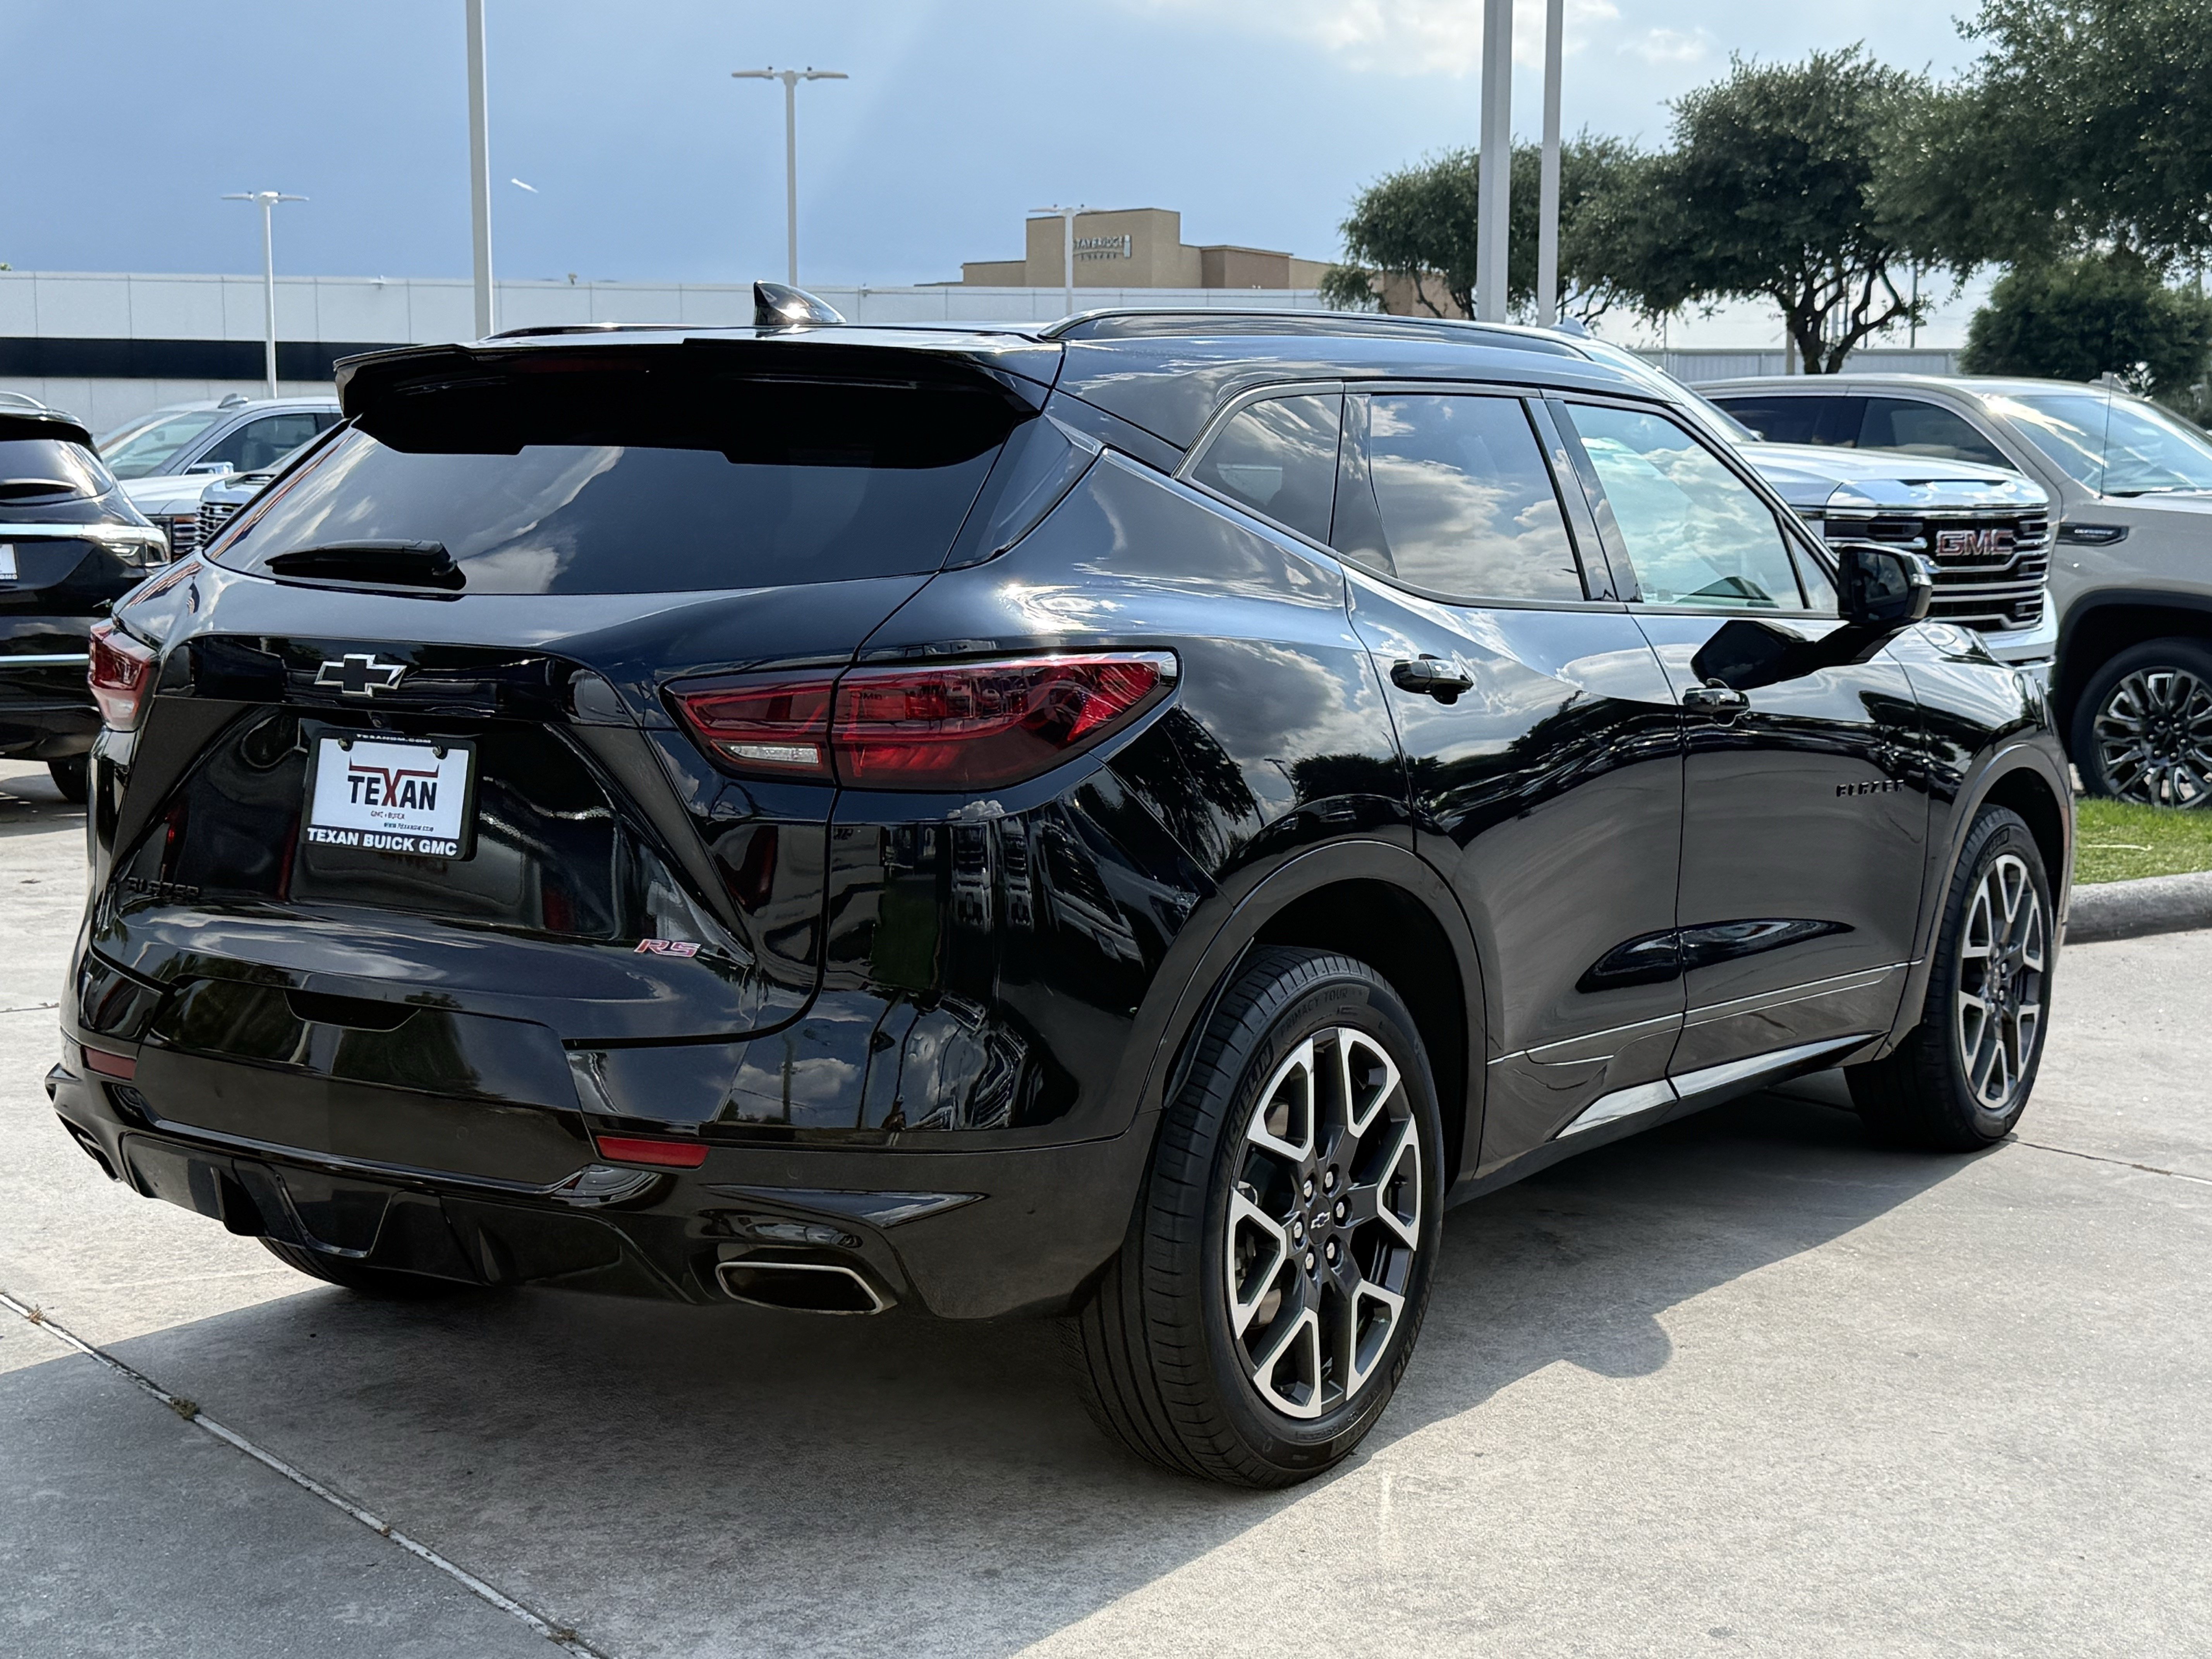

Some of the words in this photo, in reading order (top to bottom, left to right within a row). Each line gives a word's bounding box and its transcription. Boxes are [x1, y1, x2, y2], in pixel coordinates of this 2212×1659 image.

[1936, 529, 2016, 556] GMC
[348, 768, 438, 811] TEXAN
[307, 827, 359, 846] TEXAN
[362, 833, 415, 852] BUICK
[419, 840, 457, 856] GMC
[634, 938, 701, 958] RS
[1279, 995, 1320, 1037] PRIMACY
[1324, 988, 1348, 1004] TOUR
